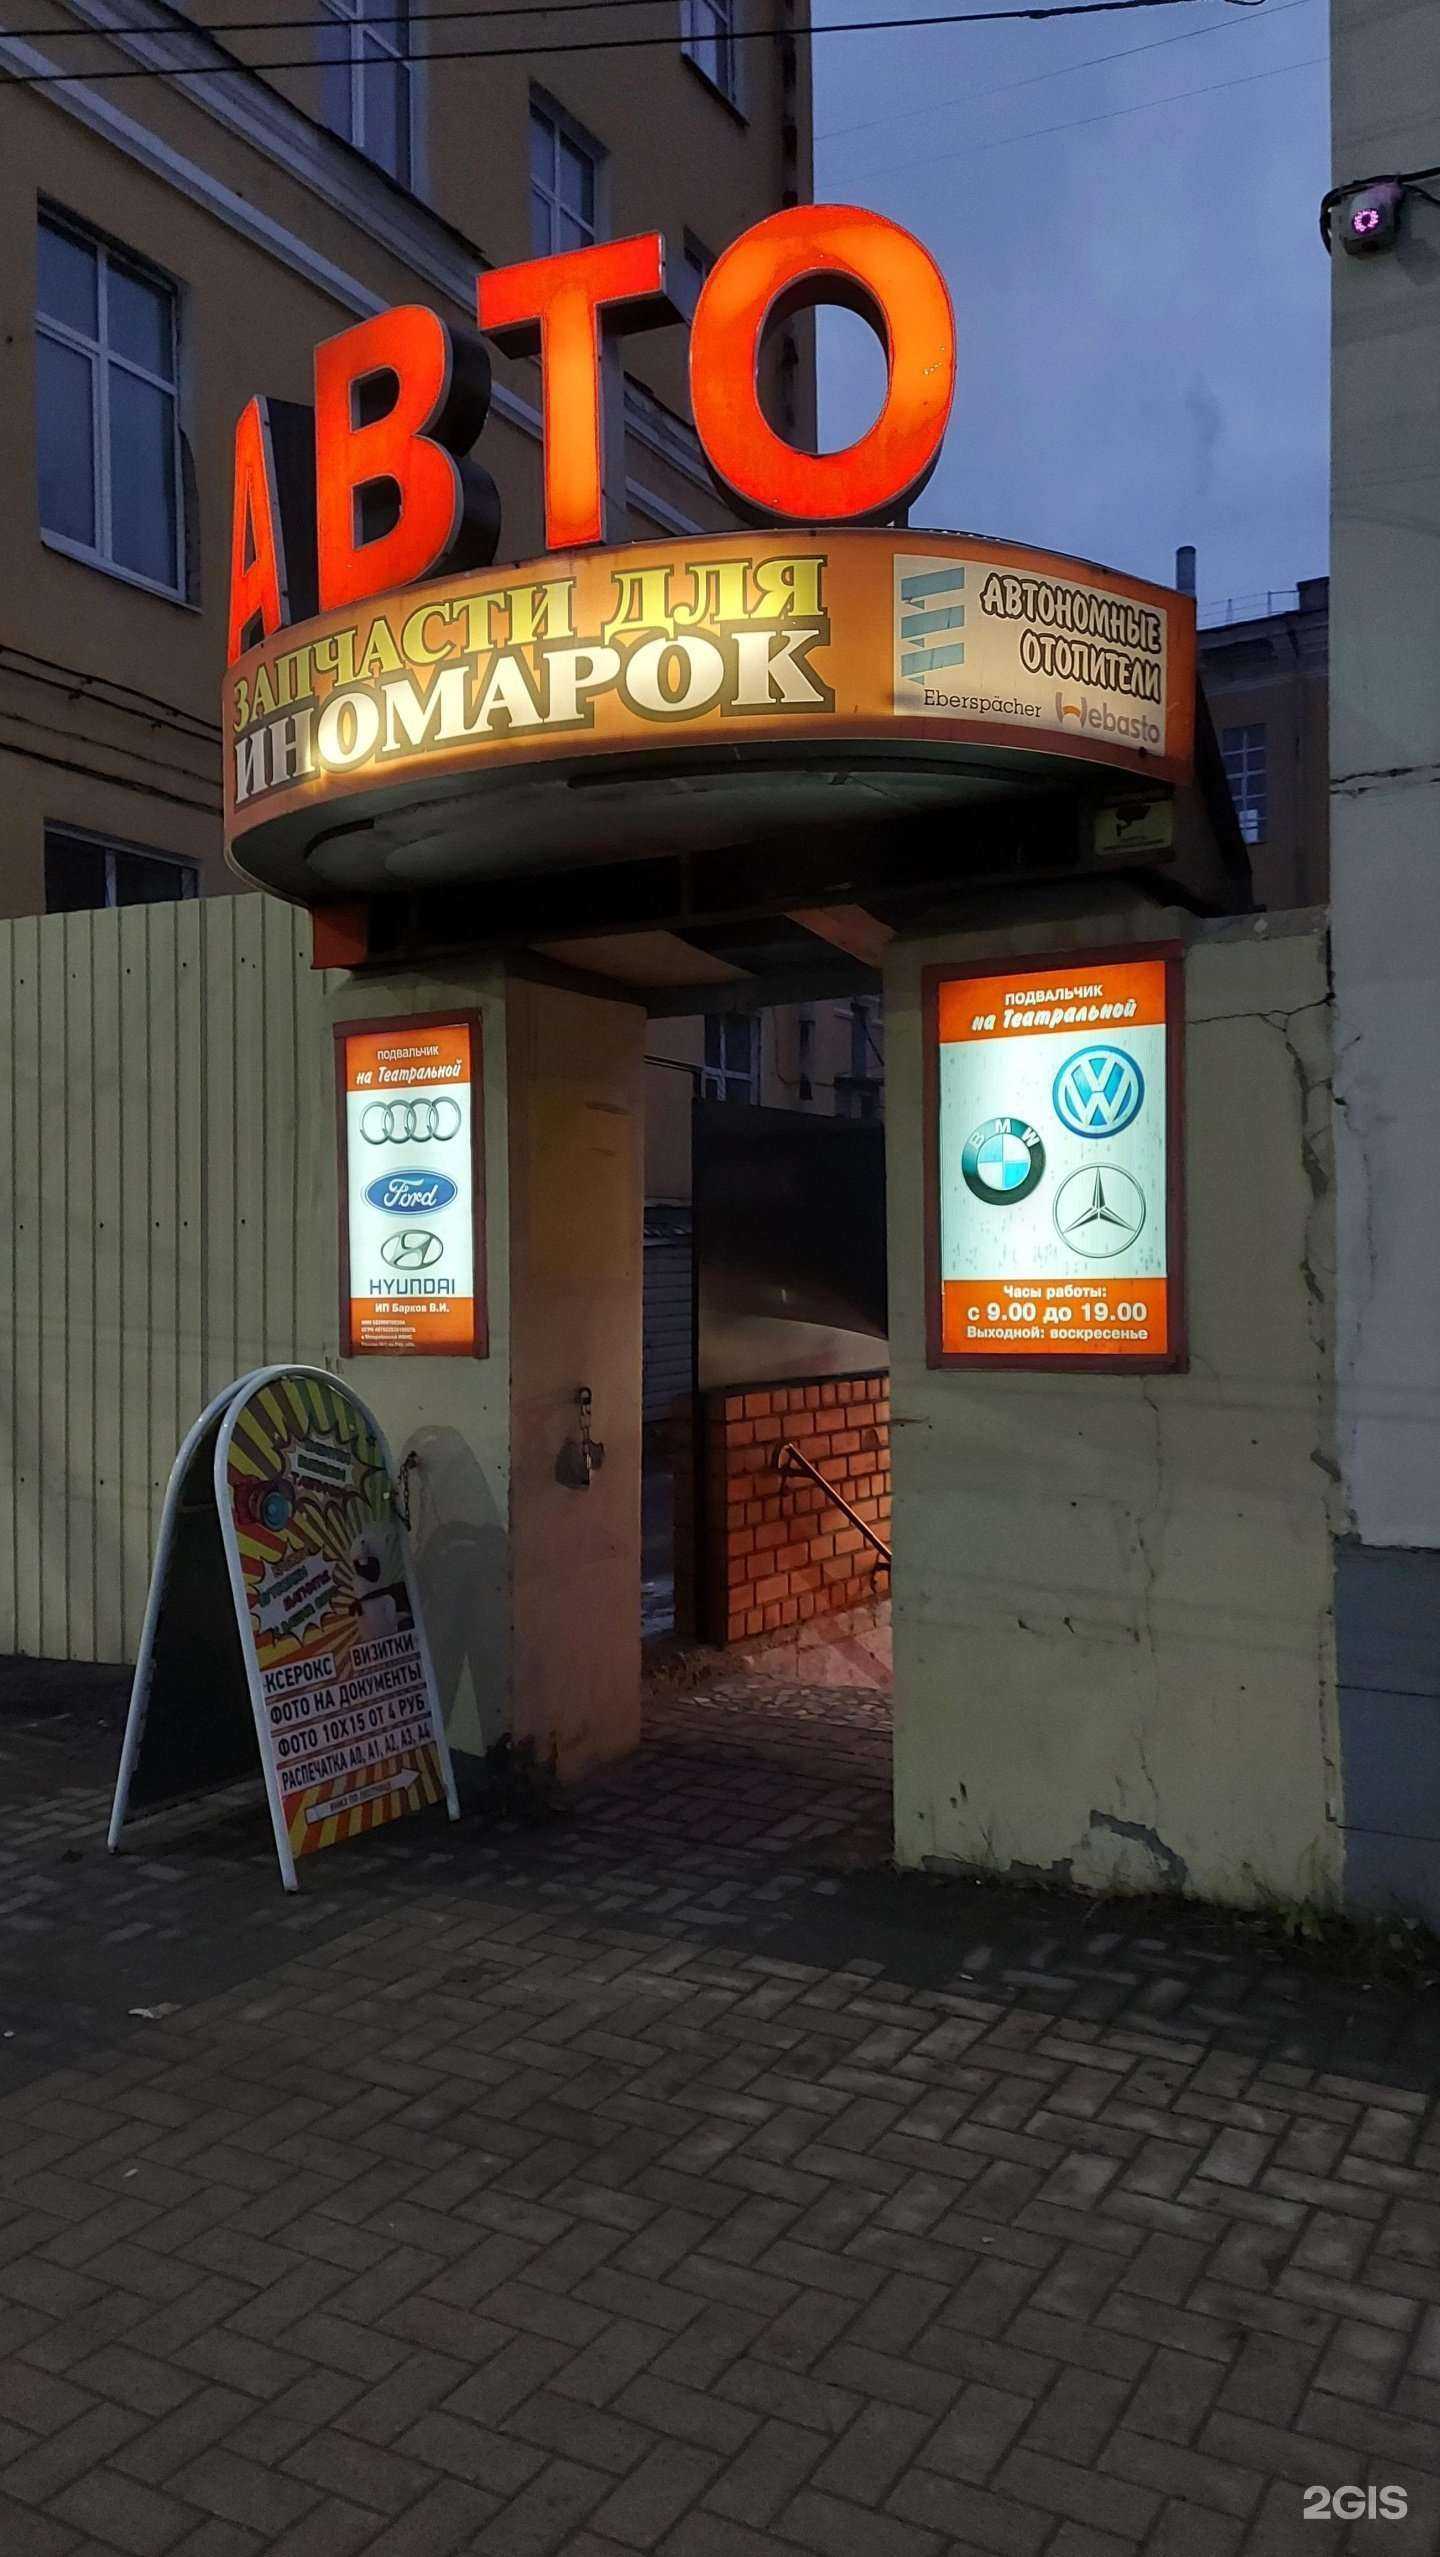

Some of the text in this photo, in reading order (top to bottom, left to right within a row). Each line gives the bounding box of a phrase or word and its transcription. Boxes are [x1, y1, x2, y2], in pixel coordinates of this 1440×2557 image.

[226, 203, 957, 668] АВТО
[979, 572, 1162, 654] АВТОНОМНЫЕ
[232, 555, 828, 734] ЗАПЧАСТИ ДЛЯ
[1020, 629, 1161, 704] ОТОПИТЕЛИ
[232, 626, 834, 808] ИНОМАРОК
[923, 689, 1042, 719] Eberspächer
[1055, 691, 1160, 744] Webasto
[1004, 984, 1103, 1007] ПОДВАЛЬЧИК
[971, 998, 1138, 1032] на Театральной
[356, 1058, 463, 1086] на Театральной
[383, 1177, 439, 1208] Ford
[369, 1278, 456, 1295] HYUNDAI
[1003, 1285, 1107, 1300] Часы работы:
[374, 1302, 450, 1314] ИП Барков В.И.
[967, 1302, 1148, 1323] с 9.00 до 19.00
[966, 1325, 1149, 1341] Выходной: воскресенье
[265, 1632, 415, 1693] КСЕРОКС ВИЗИТКИ
[270, 1662, 422, 1725] ФОТО НА ДОКУМЕНТЫ
[278, 1729, 318, 1757] ФОТО
[369, 1707, 385, 1726] ОТ
[399, 1693, 425, 1716] РУБ
[281, 1749, 348, 1791] РАСПЕЧАТКА
